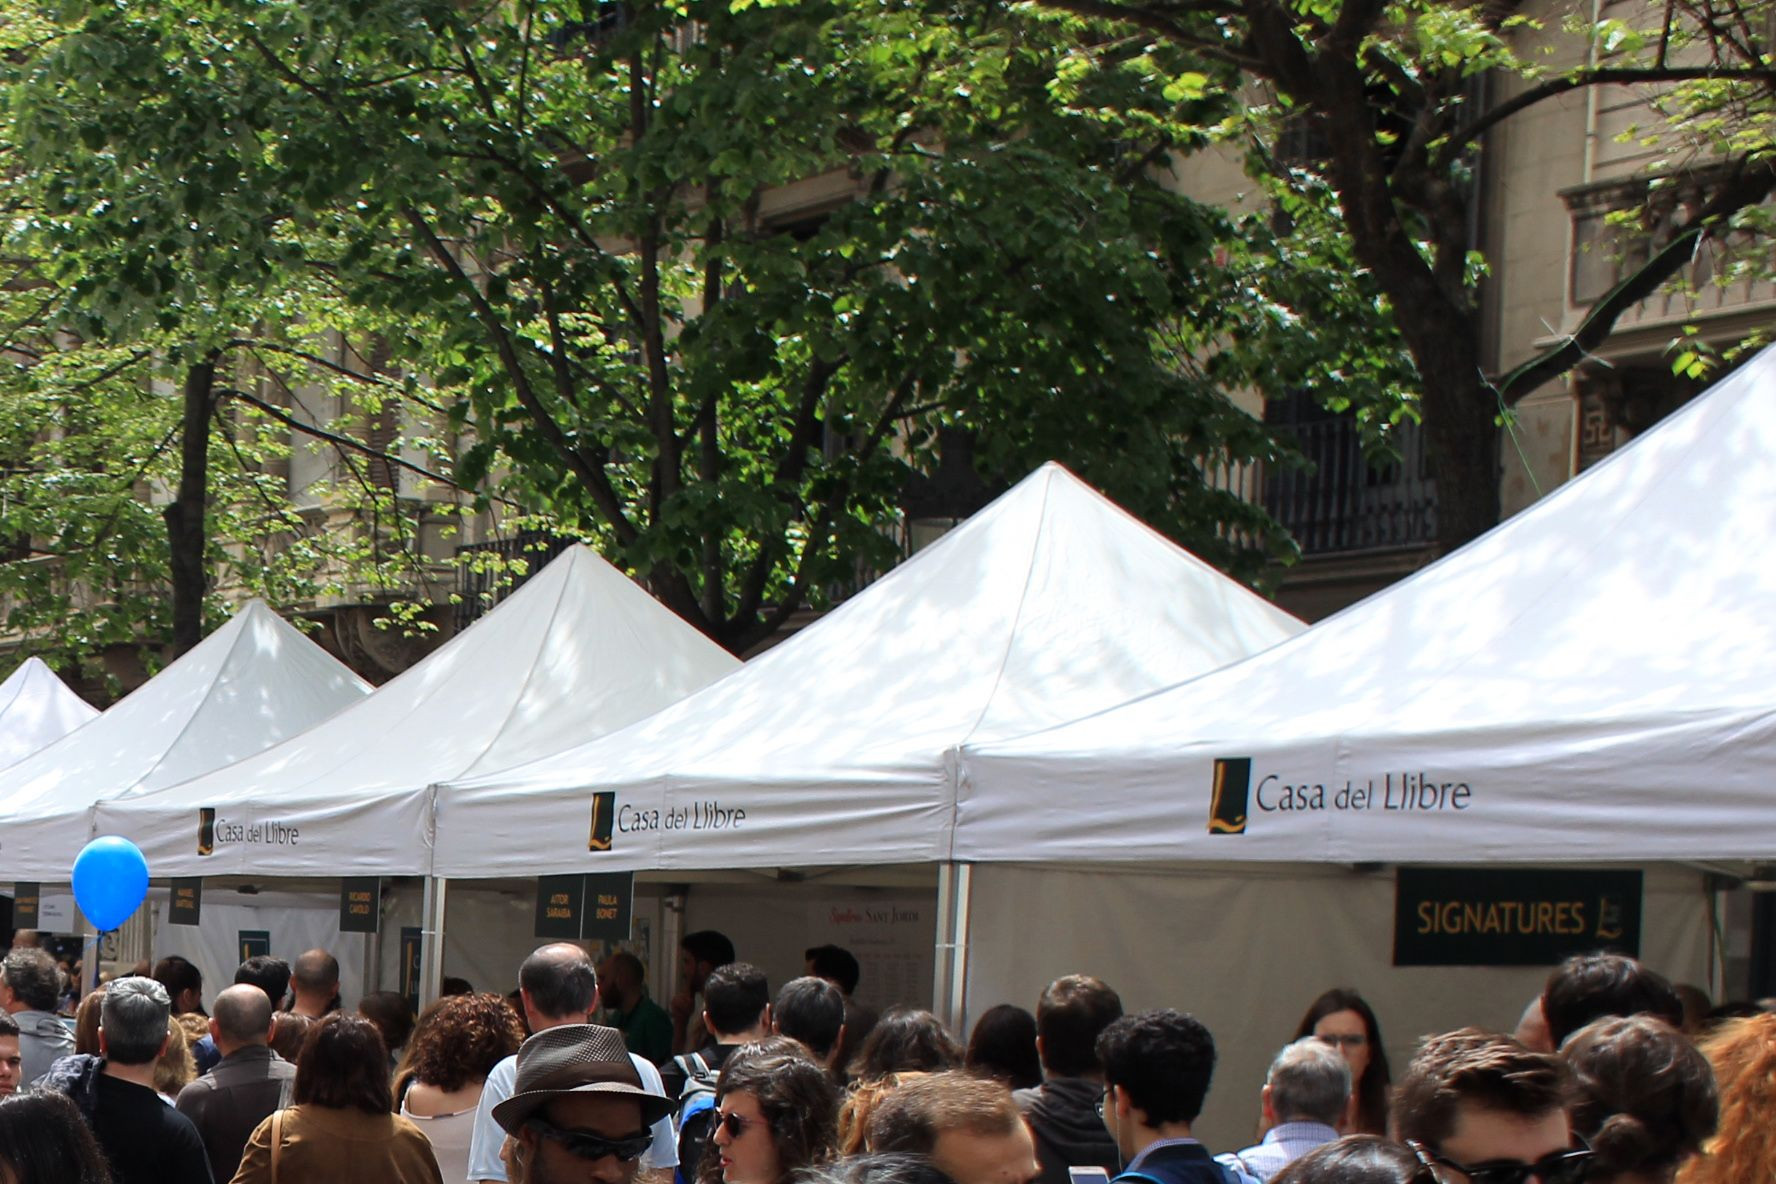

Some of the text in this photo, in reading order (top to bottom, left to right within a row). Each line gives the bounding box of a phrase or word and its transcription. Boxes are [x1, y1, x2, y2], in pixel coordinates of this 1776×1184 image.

[1255, 771, 1473, 813] Casa del Llibre
[215, 818, 300, 846] Casa del Llibre
[617, 800, 746, 834] Casa del Llibre
[1417, 900, 1585, 935] SIGNATURES
